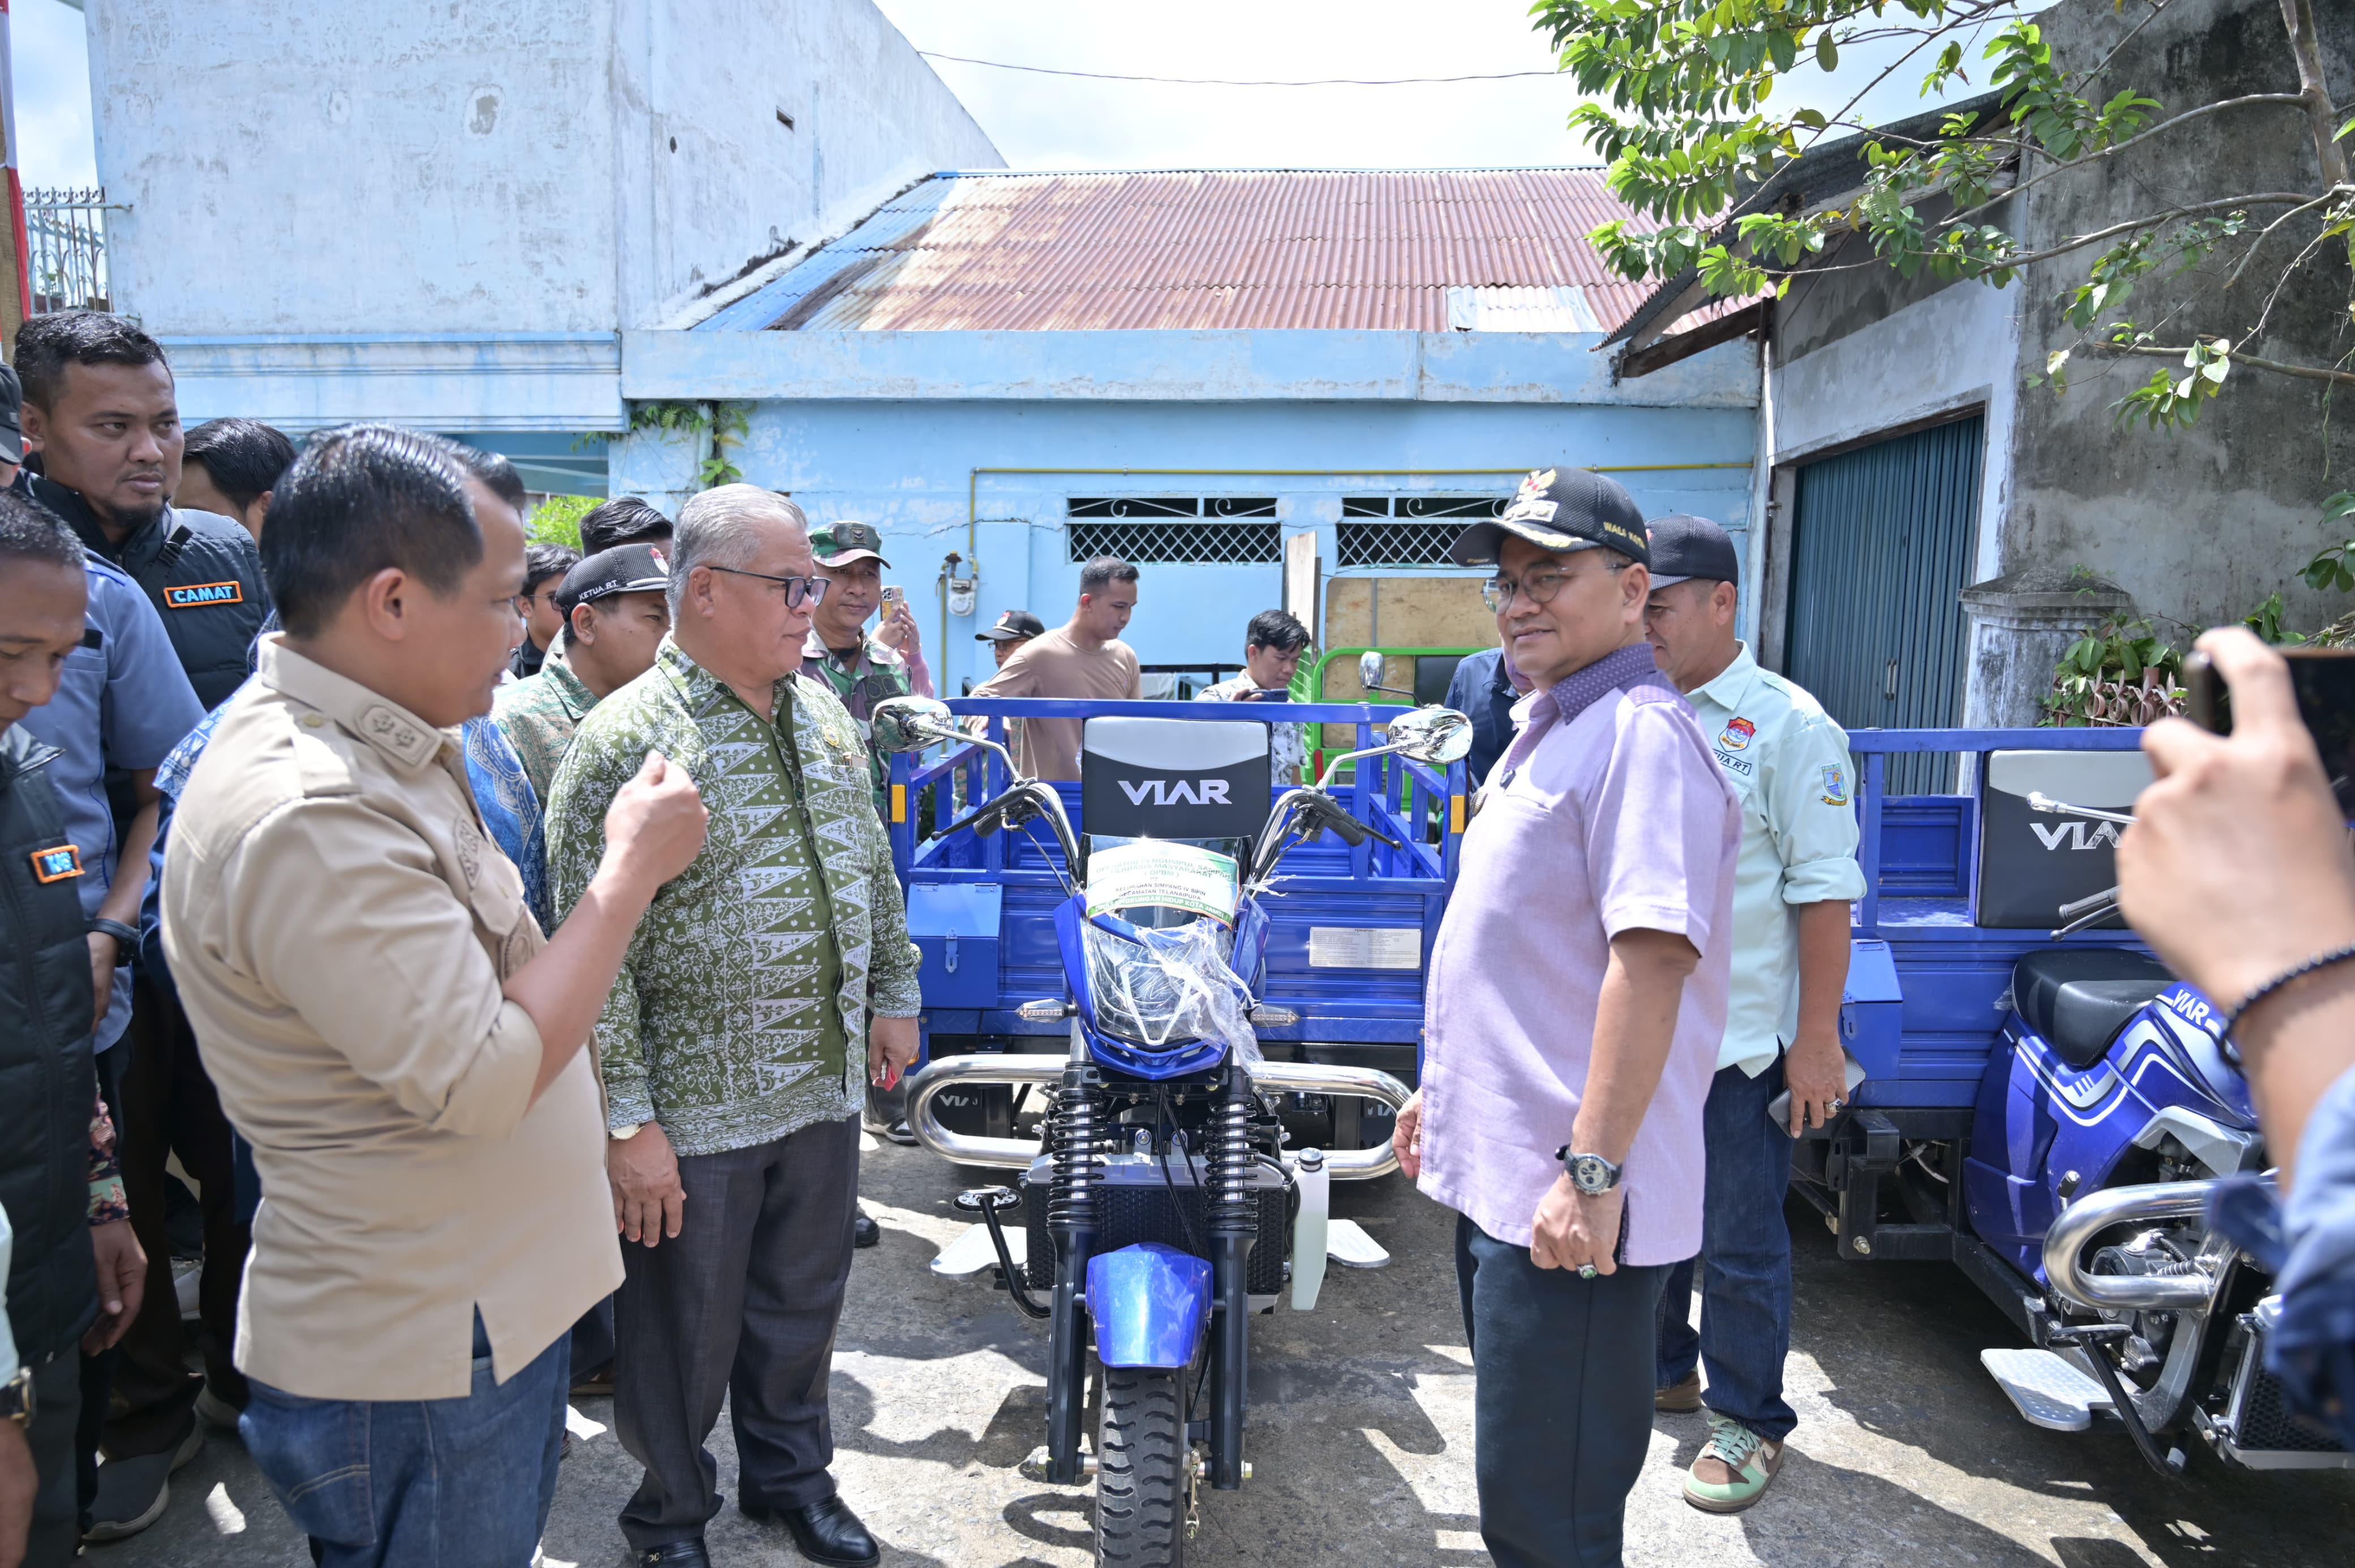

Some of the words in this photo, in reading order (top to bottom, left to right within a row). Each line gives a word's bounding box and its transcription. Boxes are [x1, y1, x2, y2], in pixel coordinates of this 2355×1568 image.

[1603, 521, 1627, 537] WALI
[174, 586, 232, 603] CAMAT
[579, 585, 605, 601] KETUA
[606, 580, 617, 589] RT
[1733, 761, 1748, 771] RT
[1117, 779, 1232, 805] VIAR
[2029, 821, 2129, 850] VIA
[1158, 889, 1201, 900] TELANAIPURA
[1185, 901, 1204, 909] KOTA
[1205, 906, 1224, 918] JAMBI
[2172, 988, 2210, 1026] VIAR
